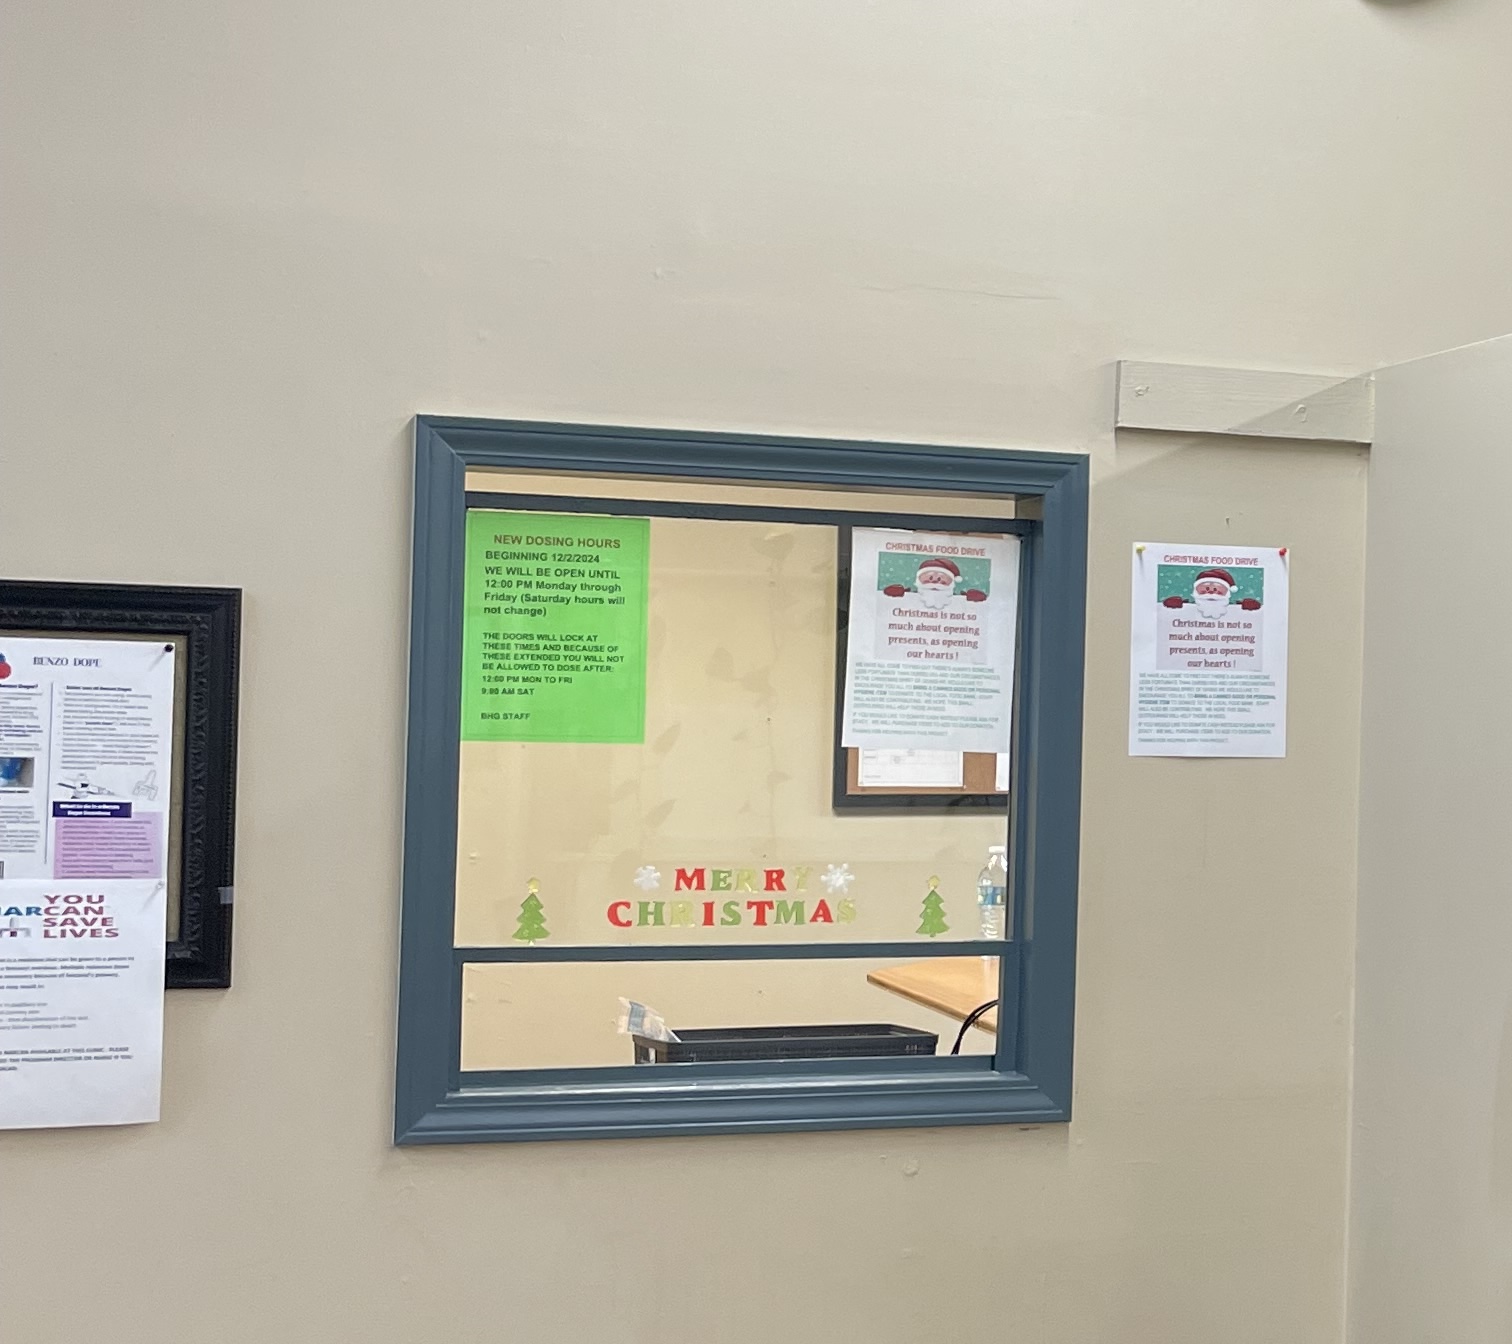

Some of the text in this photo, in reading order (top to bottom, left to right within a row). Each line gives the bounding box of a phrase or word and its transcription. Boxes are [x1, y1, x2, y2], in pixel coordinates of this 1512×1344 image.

[494, 534, 621, 548] NEW DOSING HOURS
[886, 542, 986, 556] CHRISTMAS FOOD DRIVE
[486, 551, 600, 563] BEGINNING 12/2/2024
[1164, 555, 1258, 566] CHRISTMAS FOOD DRIVE
[485, 566, 620, 579] WE WILL BE OPEN UNTIL
[486, 580, 621, 593] 12:00 PM Monday through
[484, 592, 625, 605] Friday (Saturday hours will
[484, 606, 547, 617] not change)
[893, 608, 938, 619] Christmas
[941, 610, 948, 619] is
[950, 611, 966, 620] not
[888, 622, 980, 636] much about opening
[1172, 619, 1252, 629] Christmas is not so
[483, 632, 499, 640] THE
[1169, 632, 1255, 644] much about opening
[942, 637, 979, 648] opening
[1209, 647, 1218, 655] as
[1220, 647, 1254, 657] opening
[33, 656, 102, 667] BENZO DOPE
[1187, 660, 1202, 668] our
[674, 867, 813, 892] MERRY
[44, 895, 104, 904] YOU
[0, 906, 104, 915] AR CAN
[606, 898, 857, 927] CHRISTMAS
[43, 917, 113, 927] SAVE
[44, 929, 119, 938] LIVES
